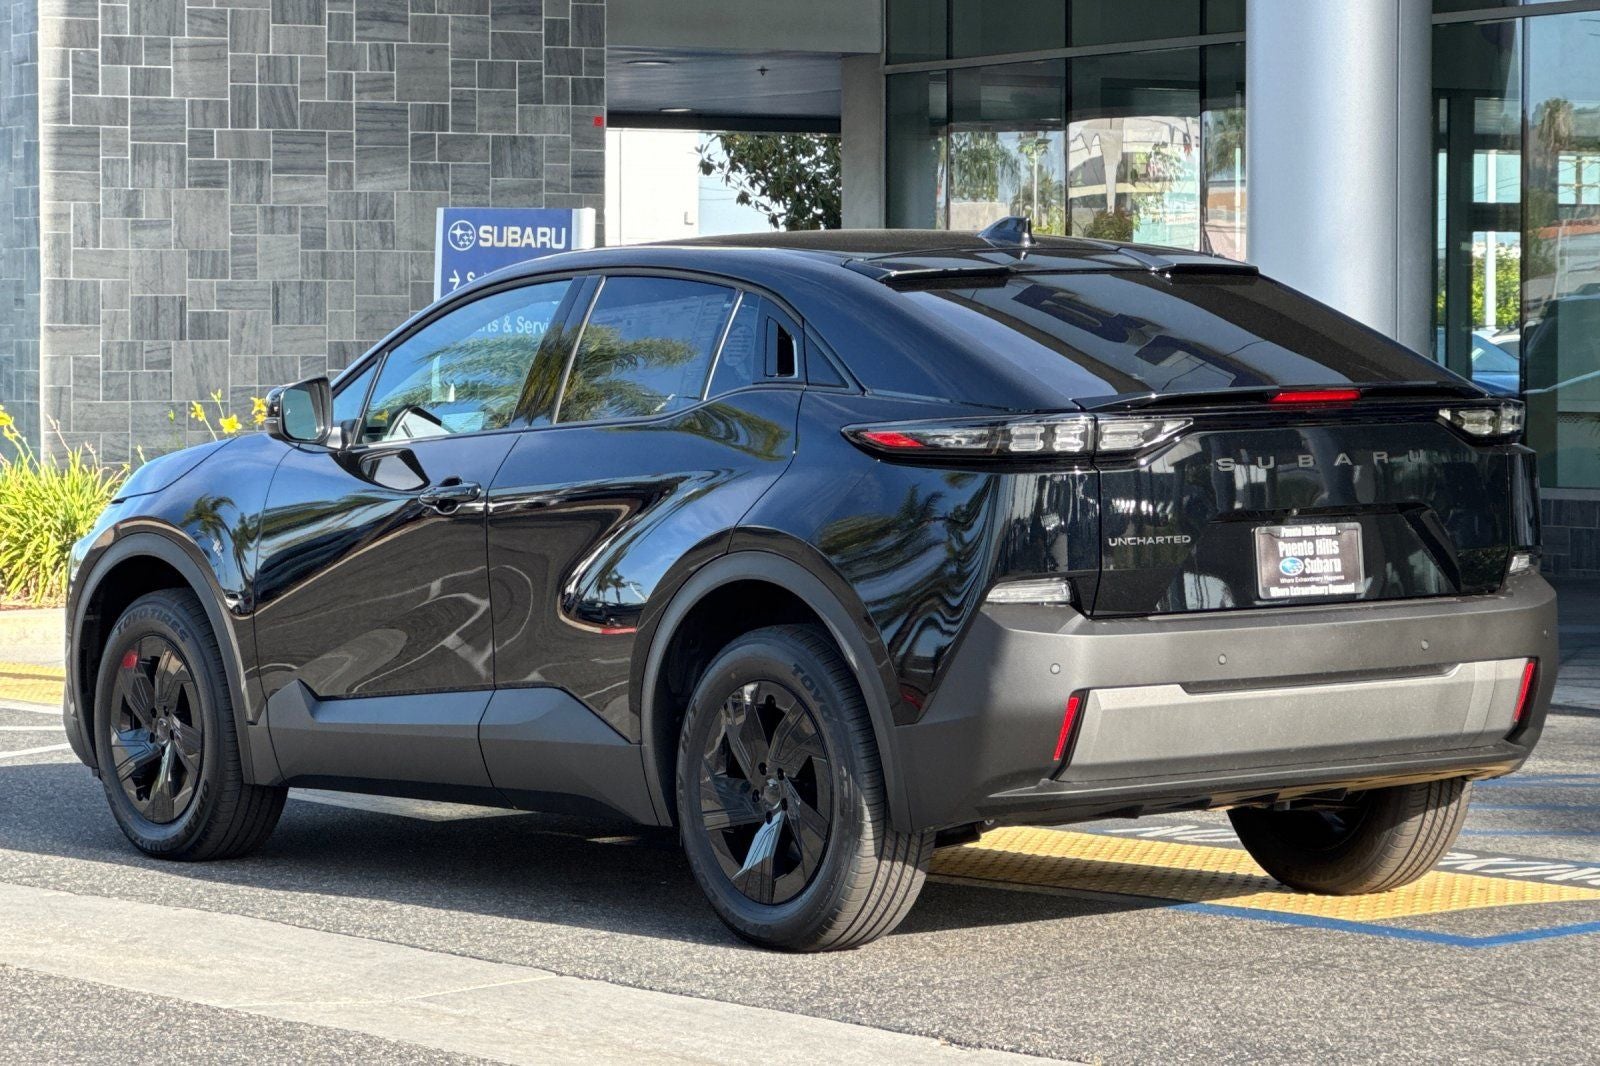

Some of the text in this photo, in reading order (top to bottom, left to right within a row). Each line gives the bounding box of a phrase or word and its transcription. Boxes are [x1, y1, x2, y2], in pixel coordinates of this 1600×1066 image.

[478, 226, 566, 249] SUBARU
[502, 315, 513, 333] &
[1216, 449, 1425, 473] SUBARU
[1108, 535, 1192, 547] UNCHARTED
[1278, 538, 1340, 557] Puente Hills
[1304, 557, 1342, 574] Subaru
[792, 663, 833, 722] TOYO
